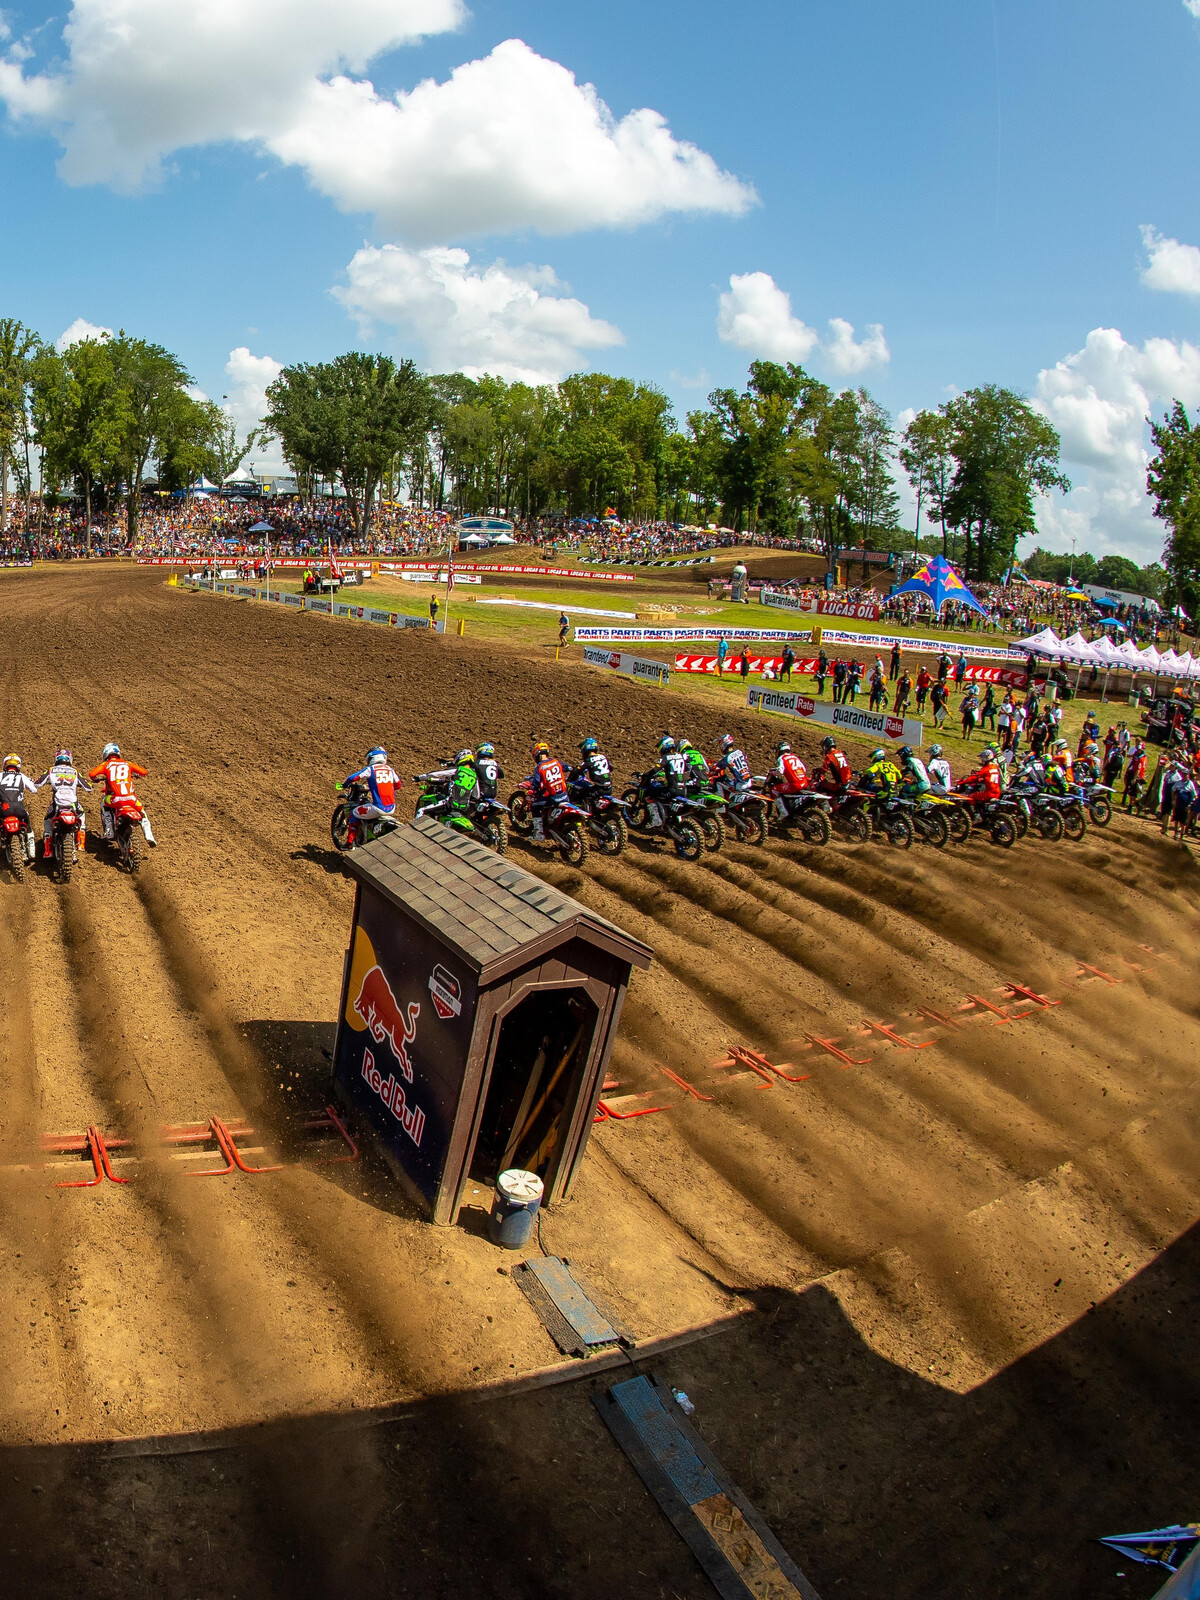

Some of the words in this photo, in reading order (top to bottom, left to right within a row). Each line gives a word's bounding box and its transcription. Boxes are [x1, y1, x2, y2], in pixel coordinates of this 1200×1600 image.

[764, 594, 799, 608] guaranteed
[822, 602, 856, 616] LUCAS
[857, 606, 874, 619] OIL
[749, 690, 794, 710] guaranteed
[798, 697, 814, 712] Rate
[832, 707, 883, 731] guaranteed
[886, 718, 903, 732] Rate
[594, 760, 610, 775] 32
[733, 756, 747, 772] 115
[0, 774, 21, 787] 41
[55, 774, 75, 786] 39
[110, 765, 129, 781] 18
[376, 770, 393, 783] 554
[455, 772, 476, 790] 38
[486, 766, 497, 780] 6
[545, 766, 561, 782] 42
